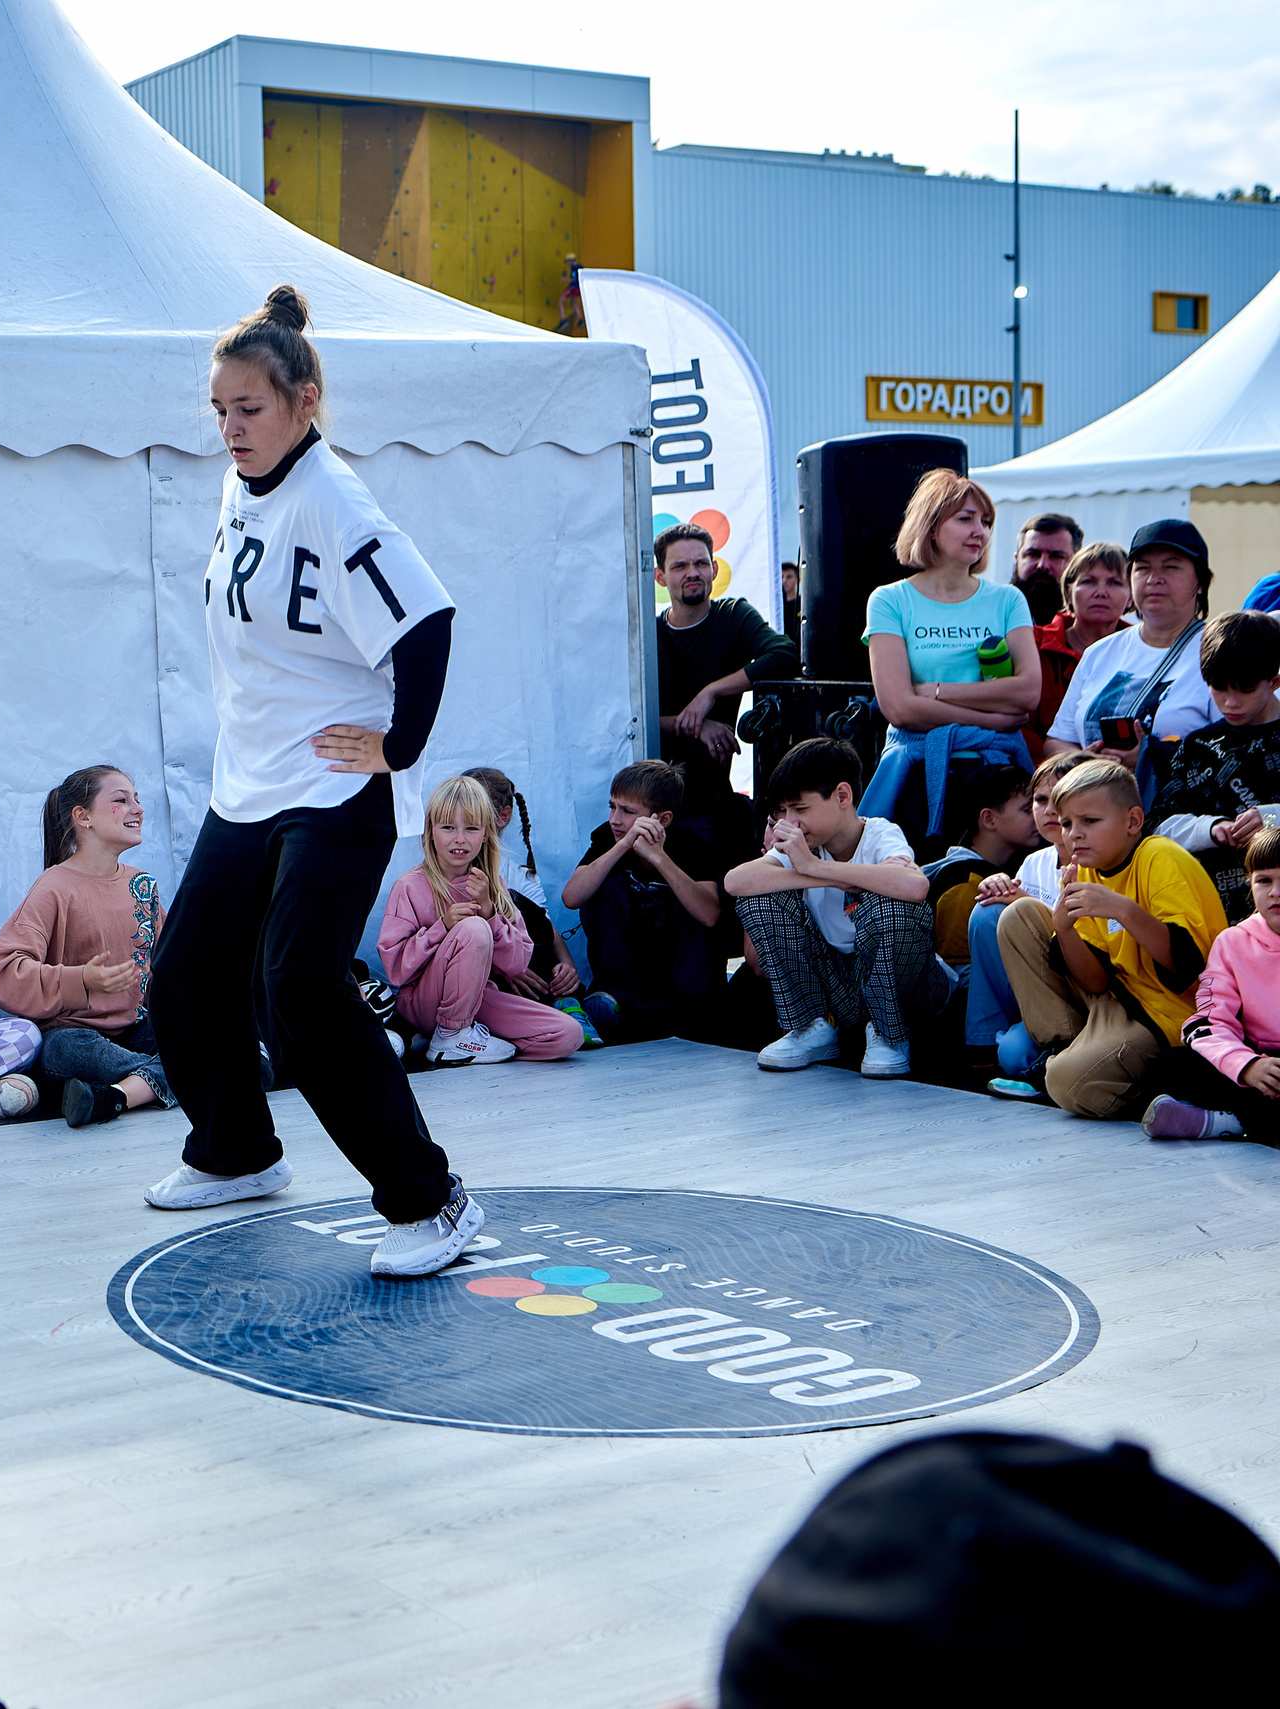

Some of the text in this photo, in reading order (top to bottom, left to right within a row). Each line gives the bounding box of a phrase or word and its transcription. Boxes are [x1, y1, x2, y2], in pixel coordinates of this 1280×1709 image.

[651, 358, 714, 495] FOOT
[915, 626, 993, 639] ORIENTA
[921, 642, 941, 651] GOOD
[458, 1042, 486, 1052] CROSBY
[520, 1223, 874, 1332] DANCE STUDIO
[592, 1307, 921, 1407] GOOD
